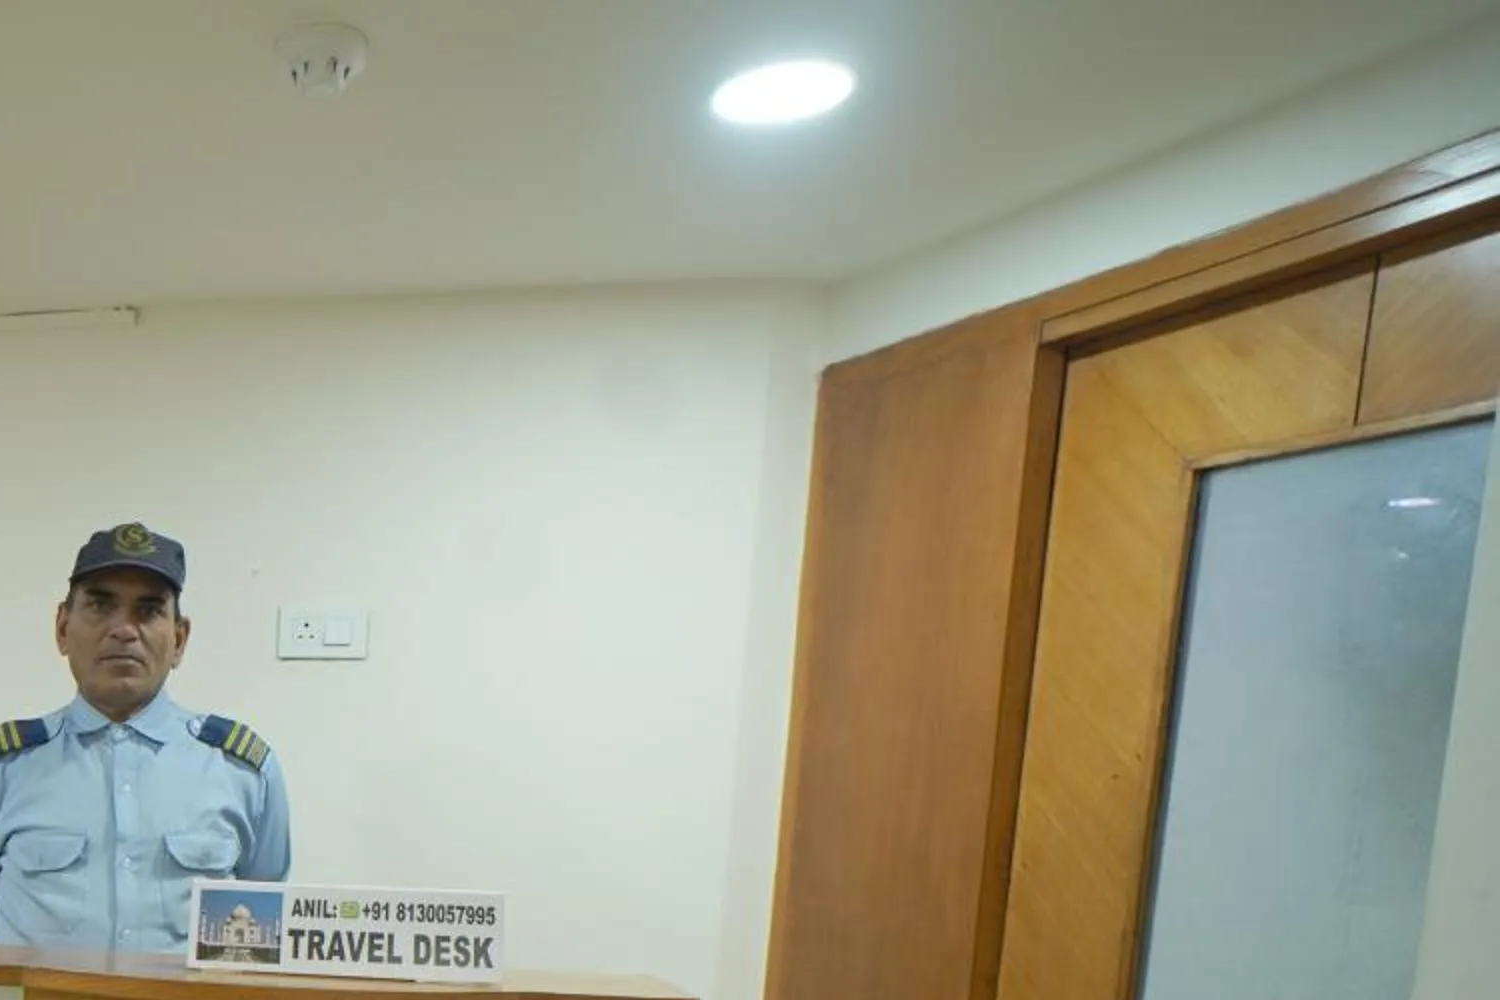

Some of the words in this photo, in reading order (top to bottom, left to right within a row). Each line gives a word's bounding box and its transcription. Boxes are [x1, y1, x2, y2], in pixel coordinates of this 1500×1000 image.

[291, 898, 338, 919] ANIL:
[362, 901, 390, 921] +91
[396, 902, 496, 925] 8130057995
[288, 928, 403, 965] TRAVEL
[413, 934, 494, 969] DESK
